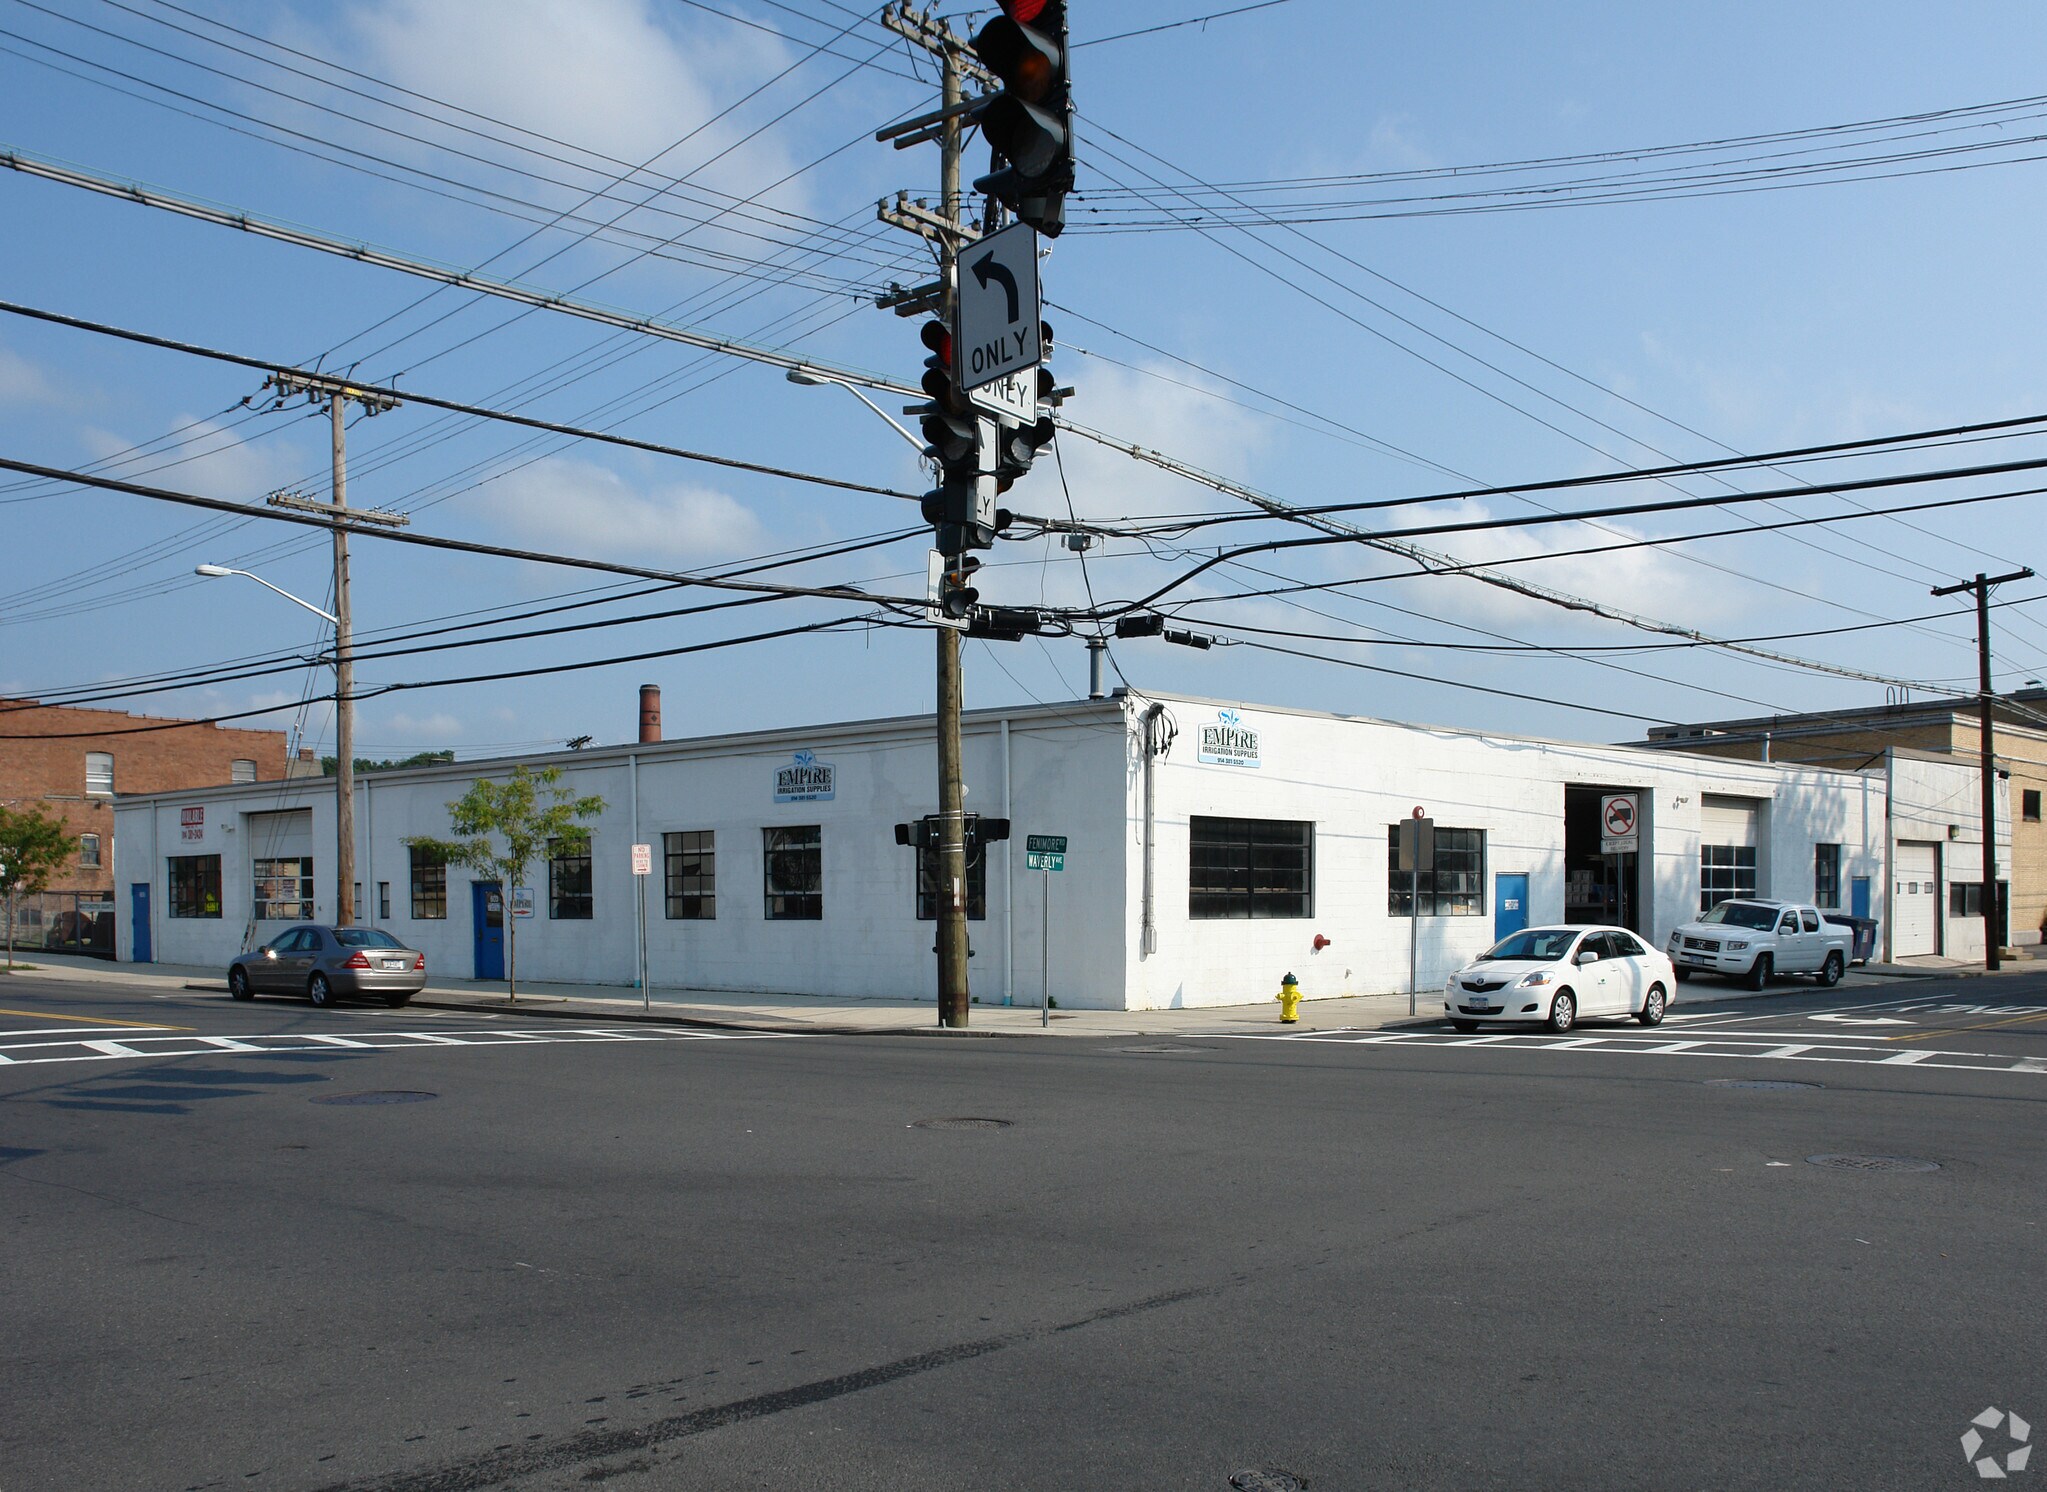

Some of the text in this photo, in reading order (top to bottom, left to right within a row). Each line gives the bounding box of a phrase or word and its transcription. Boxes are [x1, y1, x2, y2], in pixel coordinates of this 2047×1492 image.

[972, 327, 1028, 374] ONLY
[1202, 726, 1259, 750] EMPIRE
[1203, 746, 1258, 758] IRRIGATION SUPPLIES
[777, 766, 832, 787] EMPIRE
[181, 808, 204, 824] AVAILABLE
[1029, 837, 1059, 850] FENIMORE
[1028, 854, 1056, 868] WAVERLY
